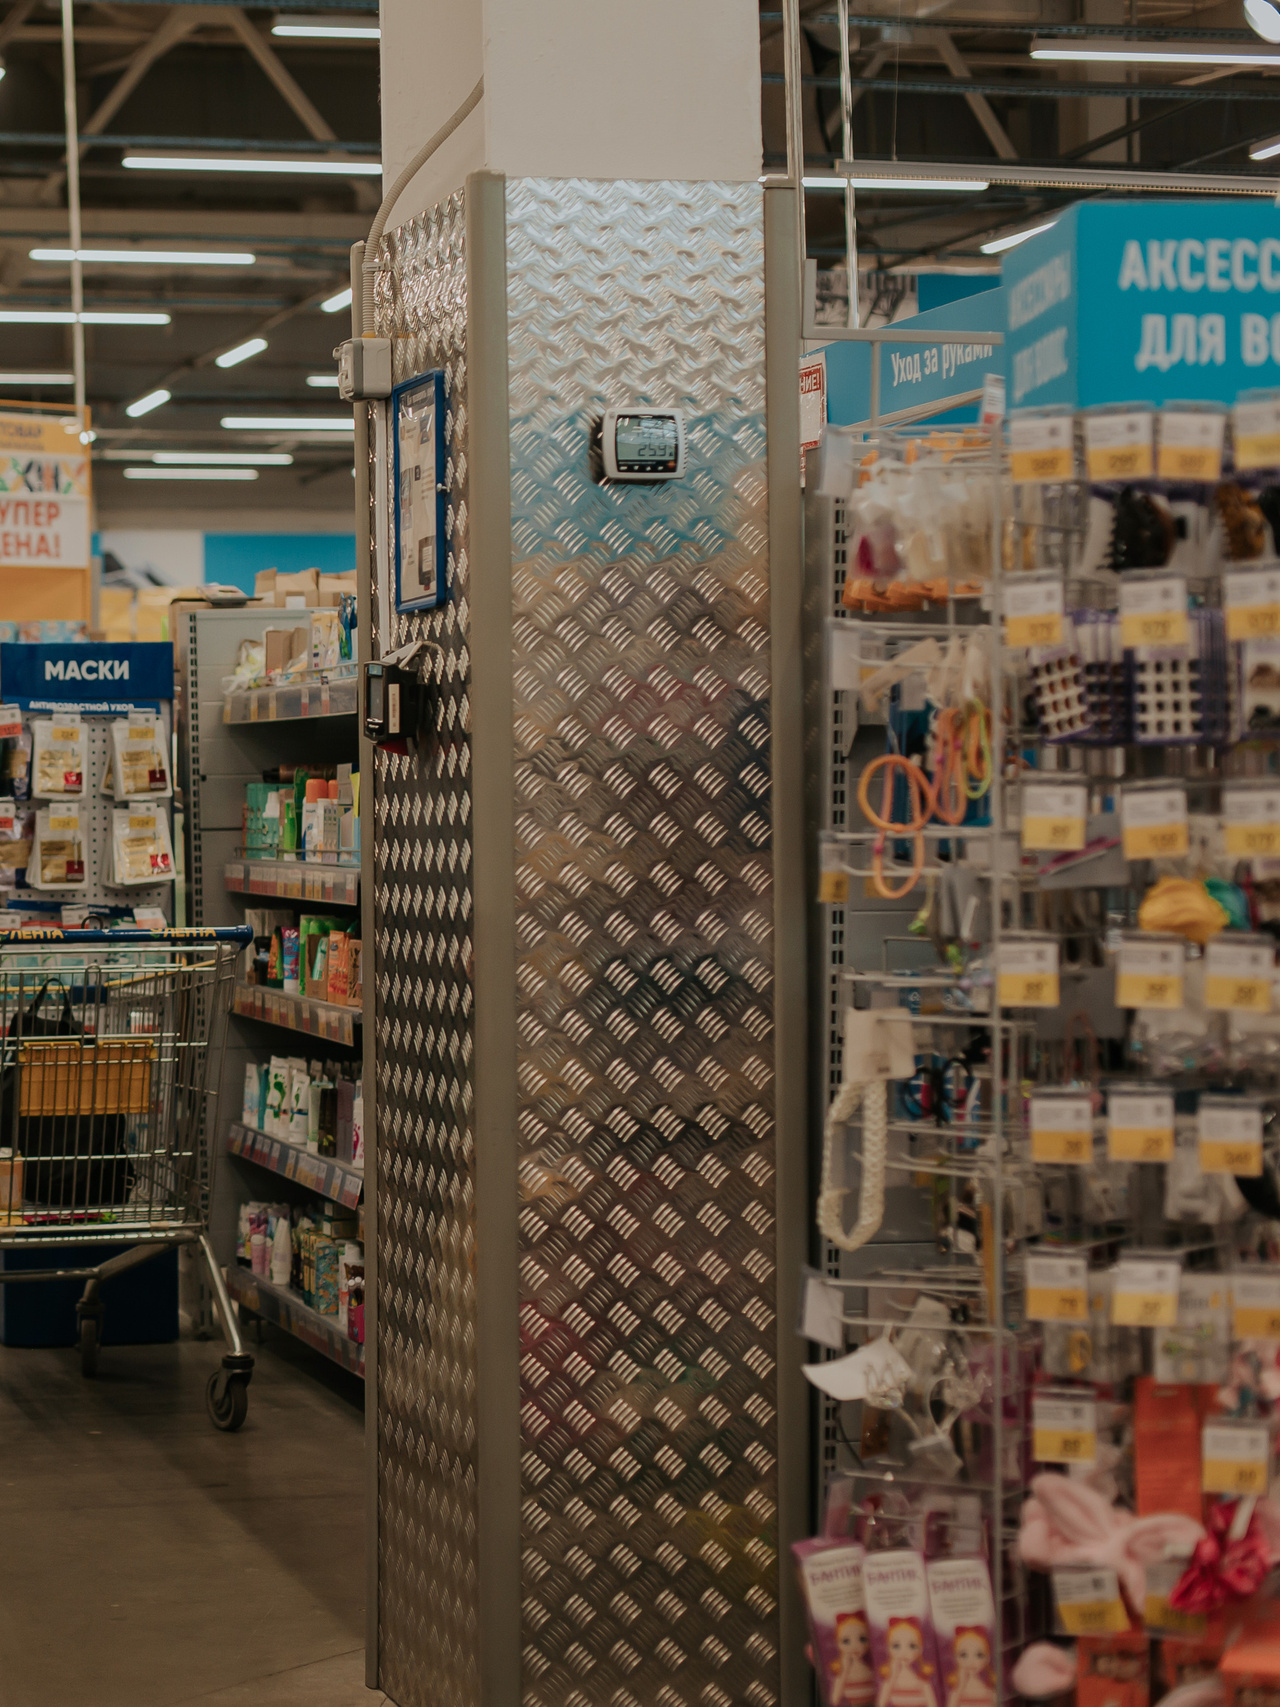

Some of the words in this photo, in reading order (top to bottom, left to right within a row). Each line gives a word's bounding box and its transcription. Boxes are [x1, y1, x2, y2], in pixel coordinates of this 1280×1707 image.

[1134, 312, 1227, 373] ДЛЯ
[891, 352, 922, 387] Уход
[924, 347, 938, 375] за
[44, 660, 130, 681] МАСКИ
[28, 700, 109, 712] АНТИВОЗРАСТНОЙ
